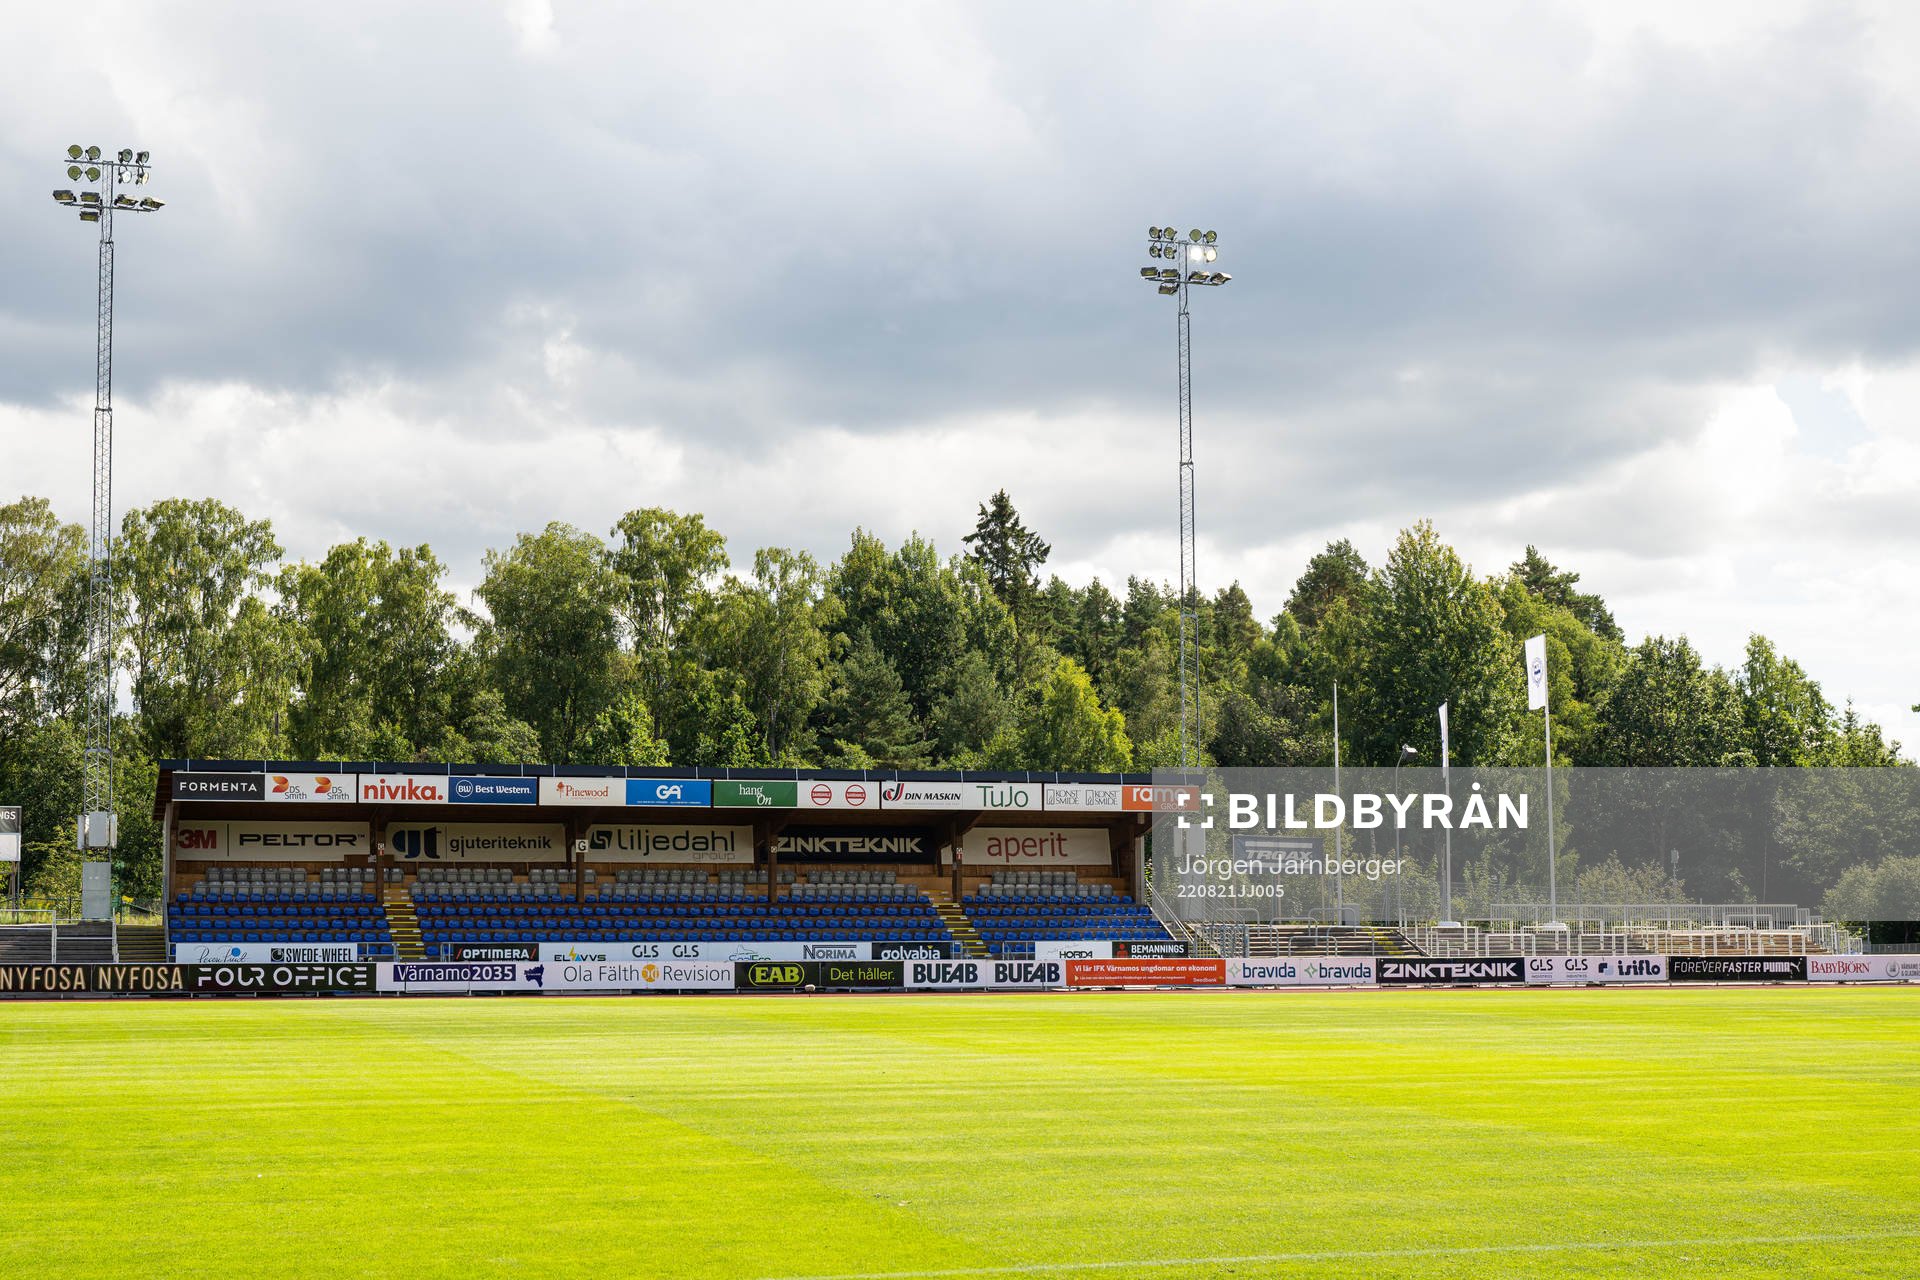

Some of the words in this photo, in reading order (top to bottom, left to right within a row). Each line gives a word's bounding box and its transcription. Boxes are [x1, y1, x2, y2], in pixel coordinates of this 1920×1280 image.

[179, 782, 257, 792] FORMENTA
[289, 786, 300, 794] DS
[331, 786, 342, 794] DS
[475, 784, 494, 794] Best
[565, 784, 609, 797] Pinewood
[656, 784, 681, 800] GA
[739, 784, 764, 797] hang
[284, 792, 307, 800] Smith
[327, 792, 349, 801] Smith
[757, 795, 772, 806] On
[923, 793, 961, 801] MASKIN
[976, 786, 1029, 808] TuJo
[178, 829, 217, 849] 3M
[618, 829, 735, 856] liljedahl
[777, 837, 923, 853] ZINKTEKNIK
[450, 836, 552, 857] gjuteriteknik
[579, 842, 586, 852] G
[987, 832, 1068, 862] aperit
[692, 853, 736, 862] group
[1246, 850, 1313, 861] TROAX
[286, 948, 353, 962] SWEDE-WHEEL
[632, 945, 659, 958] GLS
[673, 945, 699, 958] GLS
[881, 945, 940, 960] golvabia
[1131, 944, 1185, 953] BEMANNINGS
[1141, 965, 1174, 973] ungdomar
[1188, 964, 1217, 972] ekonomi
[1243, 963, 1296, 978] bravida
[1320, 963, 1372, 978] bravida
[1383, 963, 1518, 978] ZINKTEKNIK
[1530, 959, 1554, 971] GLS
[1565, 959, 1588, 971] GLS
[1618, 960, 1661, 976] isiflo
[1763, 962, 1790, 973] PUMA
[0, 967, 86, 990] NYFOSA
[98, 967, 183, 990] NYFOSA
[198, 967, 265, 986] FOUR
[273, 967, 367, 986] OFFICE
[564, 966, 592, 982] Ola
[599, 965, 640, 982] Fälth
[663, 965, 731, 982] Revision
[755, 966, 800, 983] EAB
[830, 968, 854, 981] Det
[913, 963, 978, 983] BUFAB
[995, 963, 1060, 983] BUFAB
